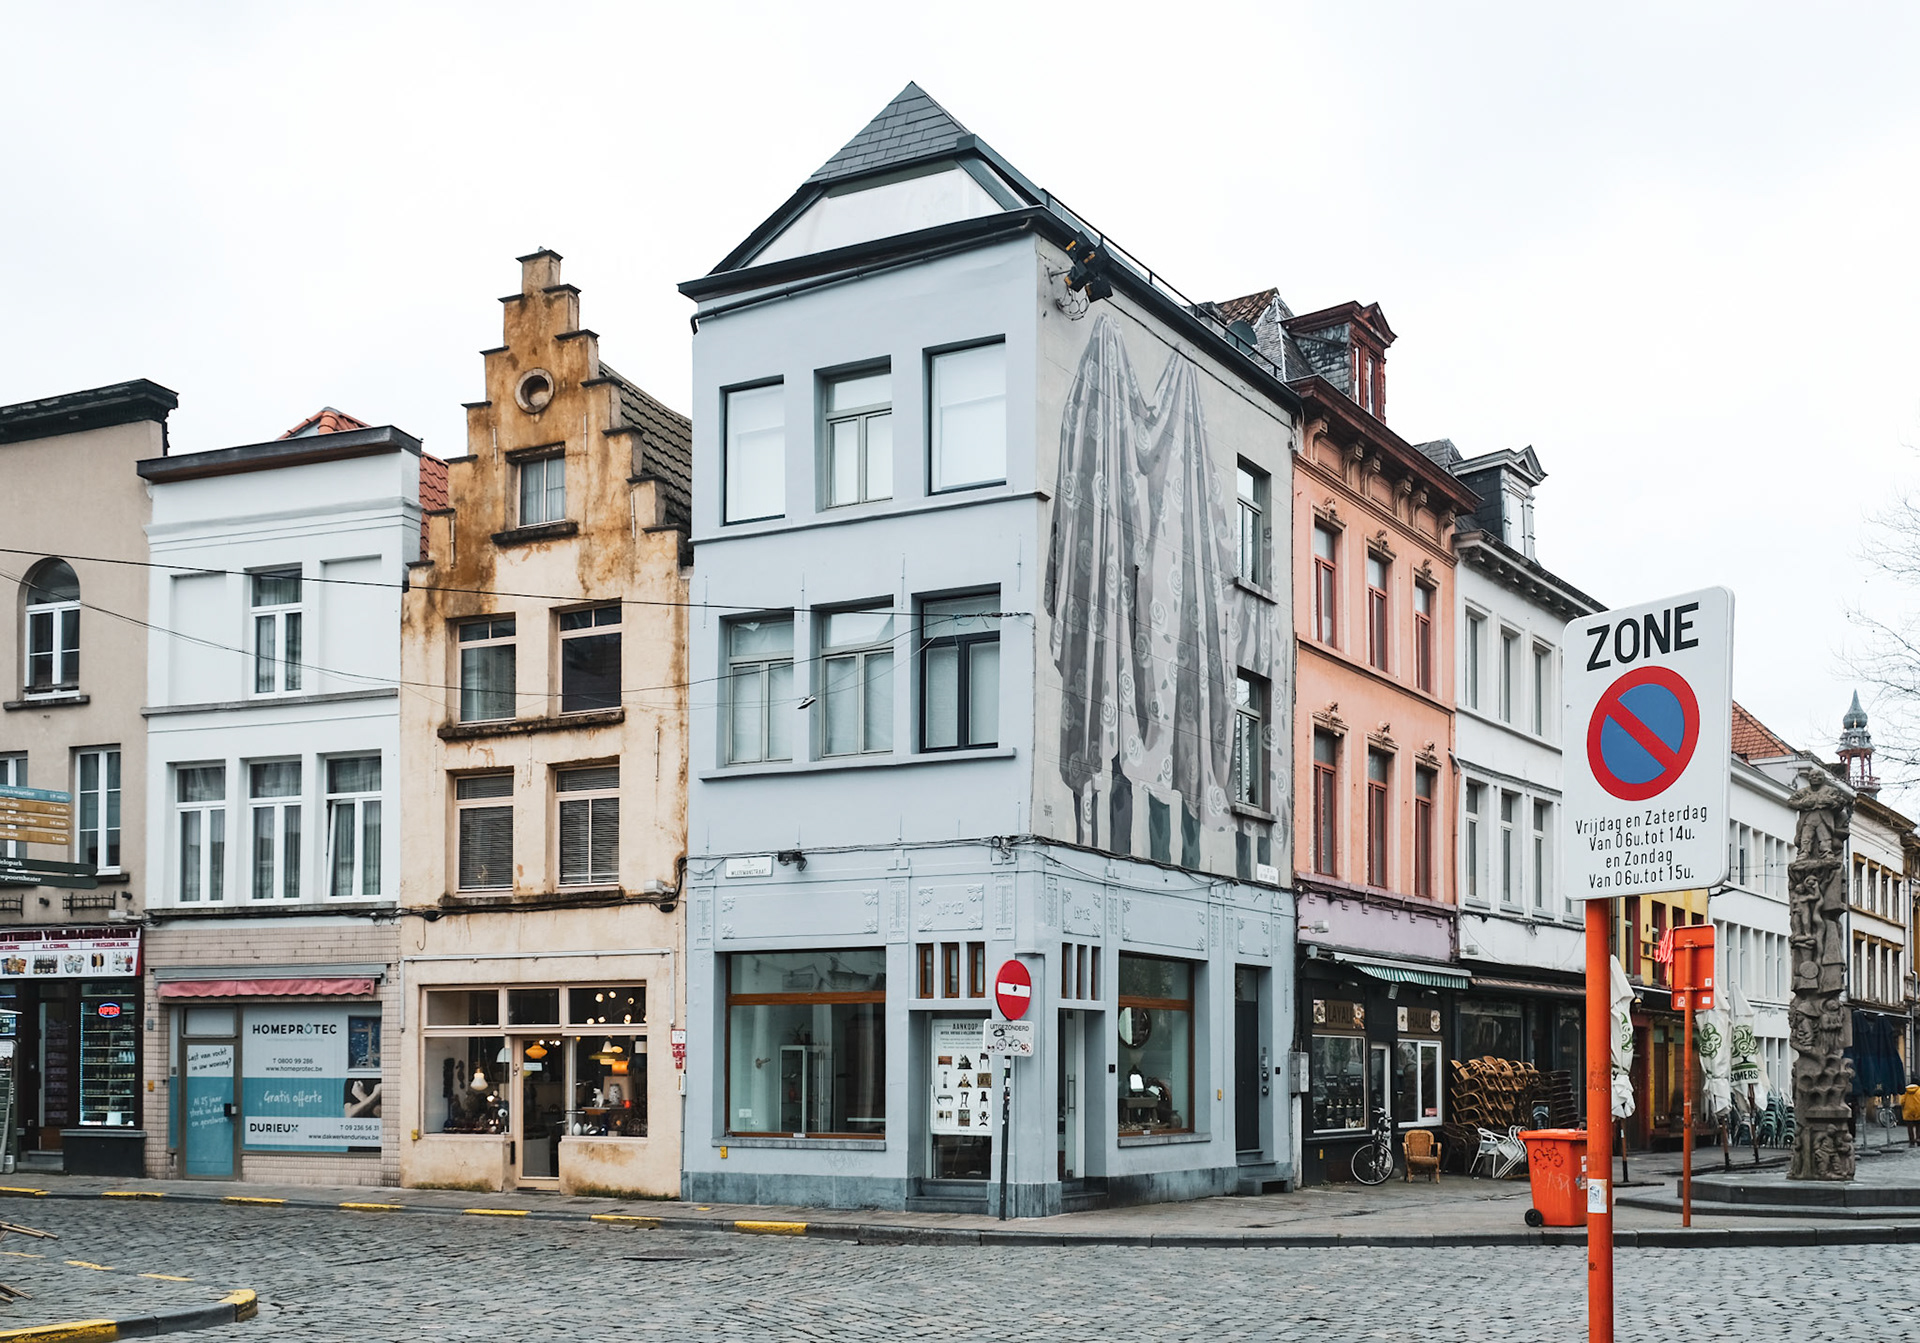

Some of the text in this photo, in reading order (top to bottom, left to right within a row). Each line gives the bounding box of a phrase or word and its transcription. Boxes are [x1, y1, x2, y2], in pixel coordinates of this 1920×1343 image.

[1587, 602, 1699, 672] ZONE
[1576, 804, 1707, 836] Vrijdag en Zaterdag
[1589, 836, 1611, 851] Van
[1669, 826, 1695, 841] 14u.
[1606, 848, 1672, 868] en Zondag
[1589, 873, 1611, 888] Van
[1669, 864, 1694, 880] 15u.
[98, 1006, 120, 1015] OPEN
[252, 1023, 338, 1035] HOMEPROTEC
[188, 1052, 199, 1062] Last
[1730, 1069, 1759, 1083] SOMERS
[263, 1090, 322, 1108] Gratis offerte
[249, 1123, 299, 1133] DURIEUX
